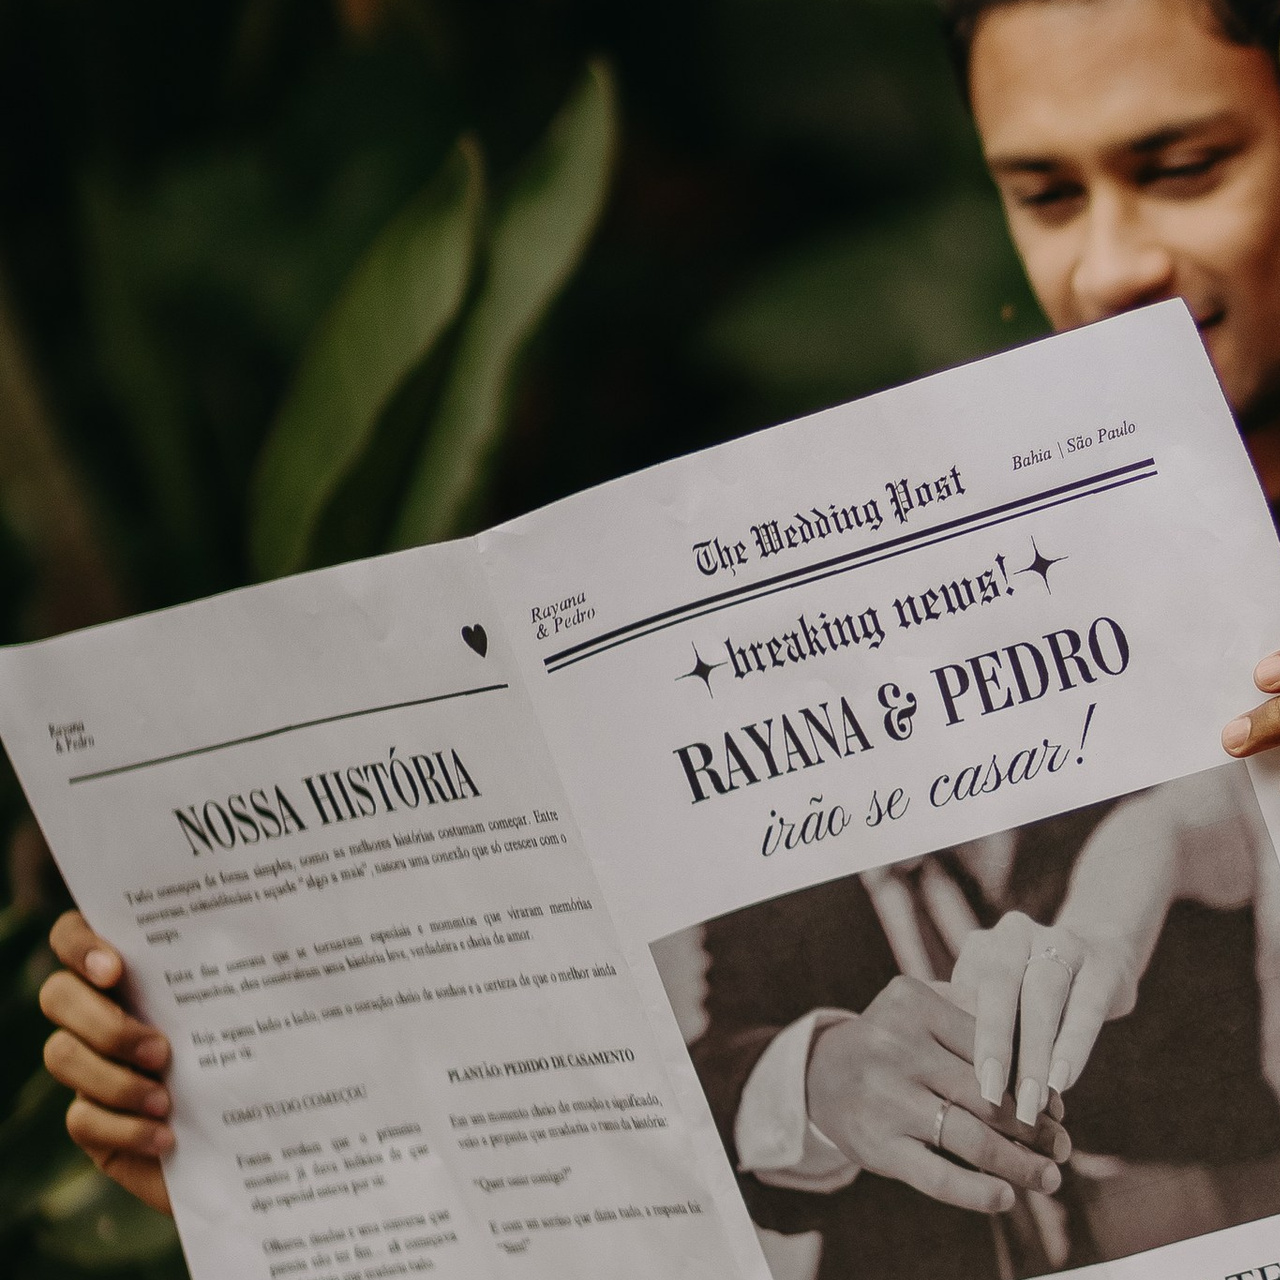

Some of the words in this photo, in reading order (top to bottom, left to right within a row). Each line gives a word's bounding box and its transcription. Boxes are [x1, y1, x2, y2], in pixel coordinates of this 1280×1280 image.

[1012, 448, 1052, 471] Bahia
[1066, 435, 1093, 453] São
[1097, 420, 1136, 444] Paulo
[692, 535, 749, 577] The
[750, 504, 883, 559] Wedding
[885, 465, 966, 524] Post
[531, 592, 587, 624] Rayana
[536, 623, 550, 640] &
[554, 608, 596, 634] Pedro
[724, 607, 886, 680] breaking
[892, 553, 1015, 629] news!
[673, 695, 874, 805] RAYANA
[877, 682, 918, 741] &
[930, 617, 1130, 726] PEDRO
[762, 794, 852, 858] irão
[865, 787, 911, 828] se
[930, 702, 1098, 808] casar!
[171, 784, 308, 856] NOSSA
[301, 746, 483, 826] HISTÓRIA
[349, 839, 392, 856] melhores
[393, 832, 435, 847] histórias
[438, 823, 486, 840] costumam
[488, 816, 531, 832] começar.
[533, 810, 559, 824] Entre
[408, 856, 430, 868] uma
[432, 846, 471, 864] conexão
[472, 846, 489, 860] que
[491, 840, 502, 854] só
[504, 838, 538, 852] cresceu
[539, 835, 560, 847] com
[560, 834, 568, 844] o
[430, 917, 478, 933] momentos
[484, 913, 502, 927] que
[507, 907, 544, 920] viraram
[549, 898, 593, 915] memórias
[460, 941, 466, 951] e
[467, 936, 492, 949] cheia
[493, 932, 506, 945] de
[506, 930, 533, 943] amor.
[476, 984, 483, 994] a
[484, 979, 518, 993] certeza
[519, 974, 531, 987] de
[533, 974, 549, 988] que
[550, 973, 558, 983] o
[558, 967, 590, 982] melhor
[592, 963, 617, 978] ainda
[504, 1058, 550, 1076] PEDIDO
[550, 1056, 568, 1069] DE
[567, 1049, 635, 1067] CASAMENTO
[558, 1101, 571, 1114] de
[612, 1094, 663, 1112] significado,
